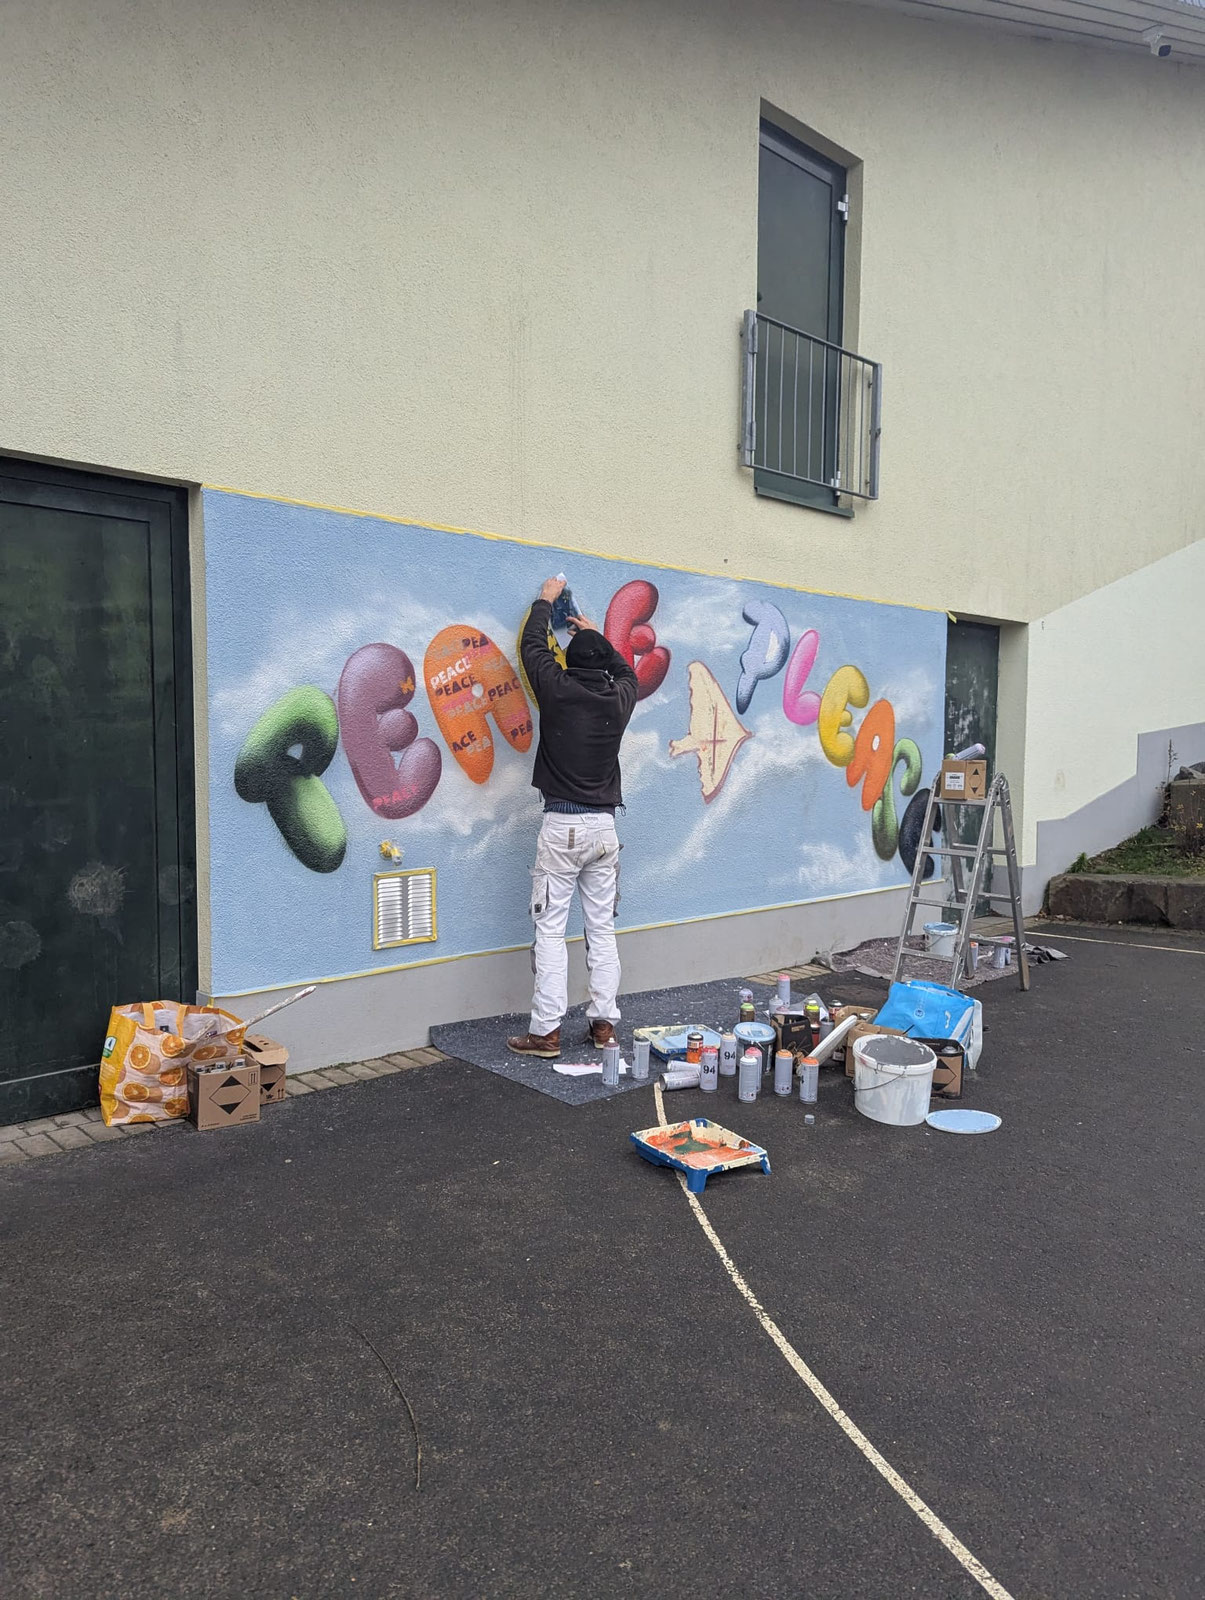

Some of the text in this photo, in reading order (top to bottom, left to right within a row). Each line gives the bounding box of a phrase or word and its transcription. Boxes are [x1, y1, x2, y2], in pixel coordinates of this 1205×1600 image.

[435, 674, 477, 696] PEACE
[488, 677, 521, 702] PEAC
[234, 580, 671, 873] PEAE
[452, 730, 476, 753] ACE
[736, 600, 941, 879] PLEASE
[724, 1051, 736, 1060] 94
[703, 1065, 715, 1074] 94
